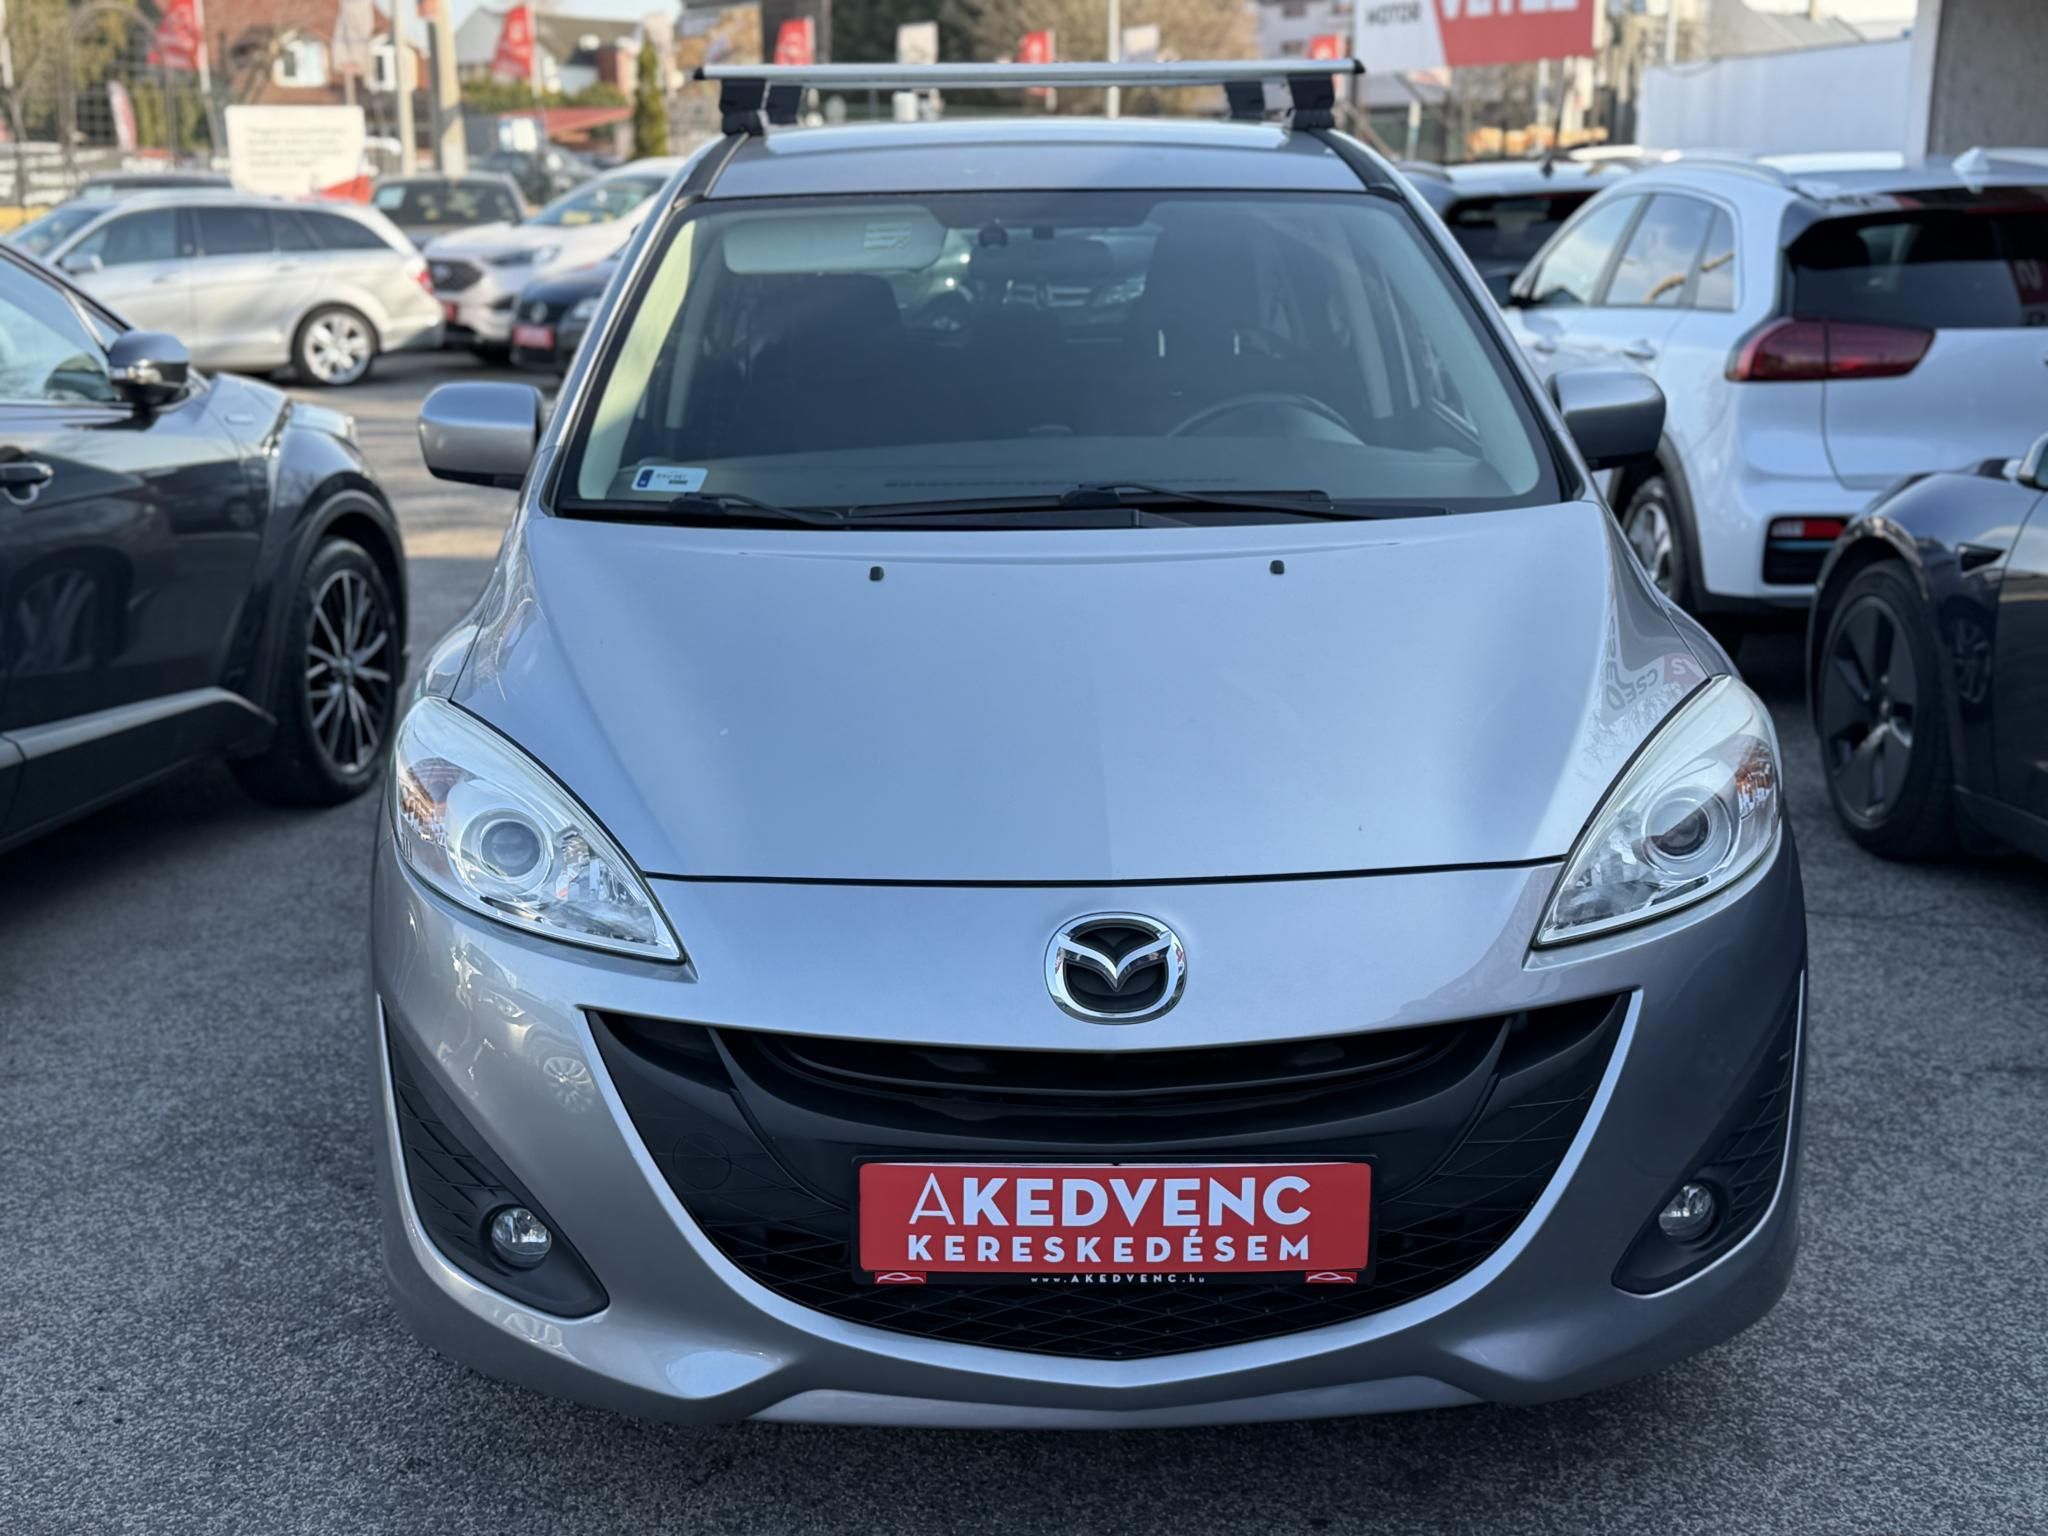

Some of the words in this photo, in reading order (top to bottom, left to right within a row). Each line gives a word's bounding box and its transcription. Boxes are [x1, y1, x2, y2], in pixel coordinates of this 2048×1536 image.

[1366, 2, 1421, 25] MOTOR
[908, 1172, 1311, 1228] AKEDVENC
[907, 1228, 1310, 1263] KERESKEDÉSEM
[1030, 1273, 1206, 1284] www.AKEDVENC.hu
